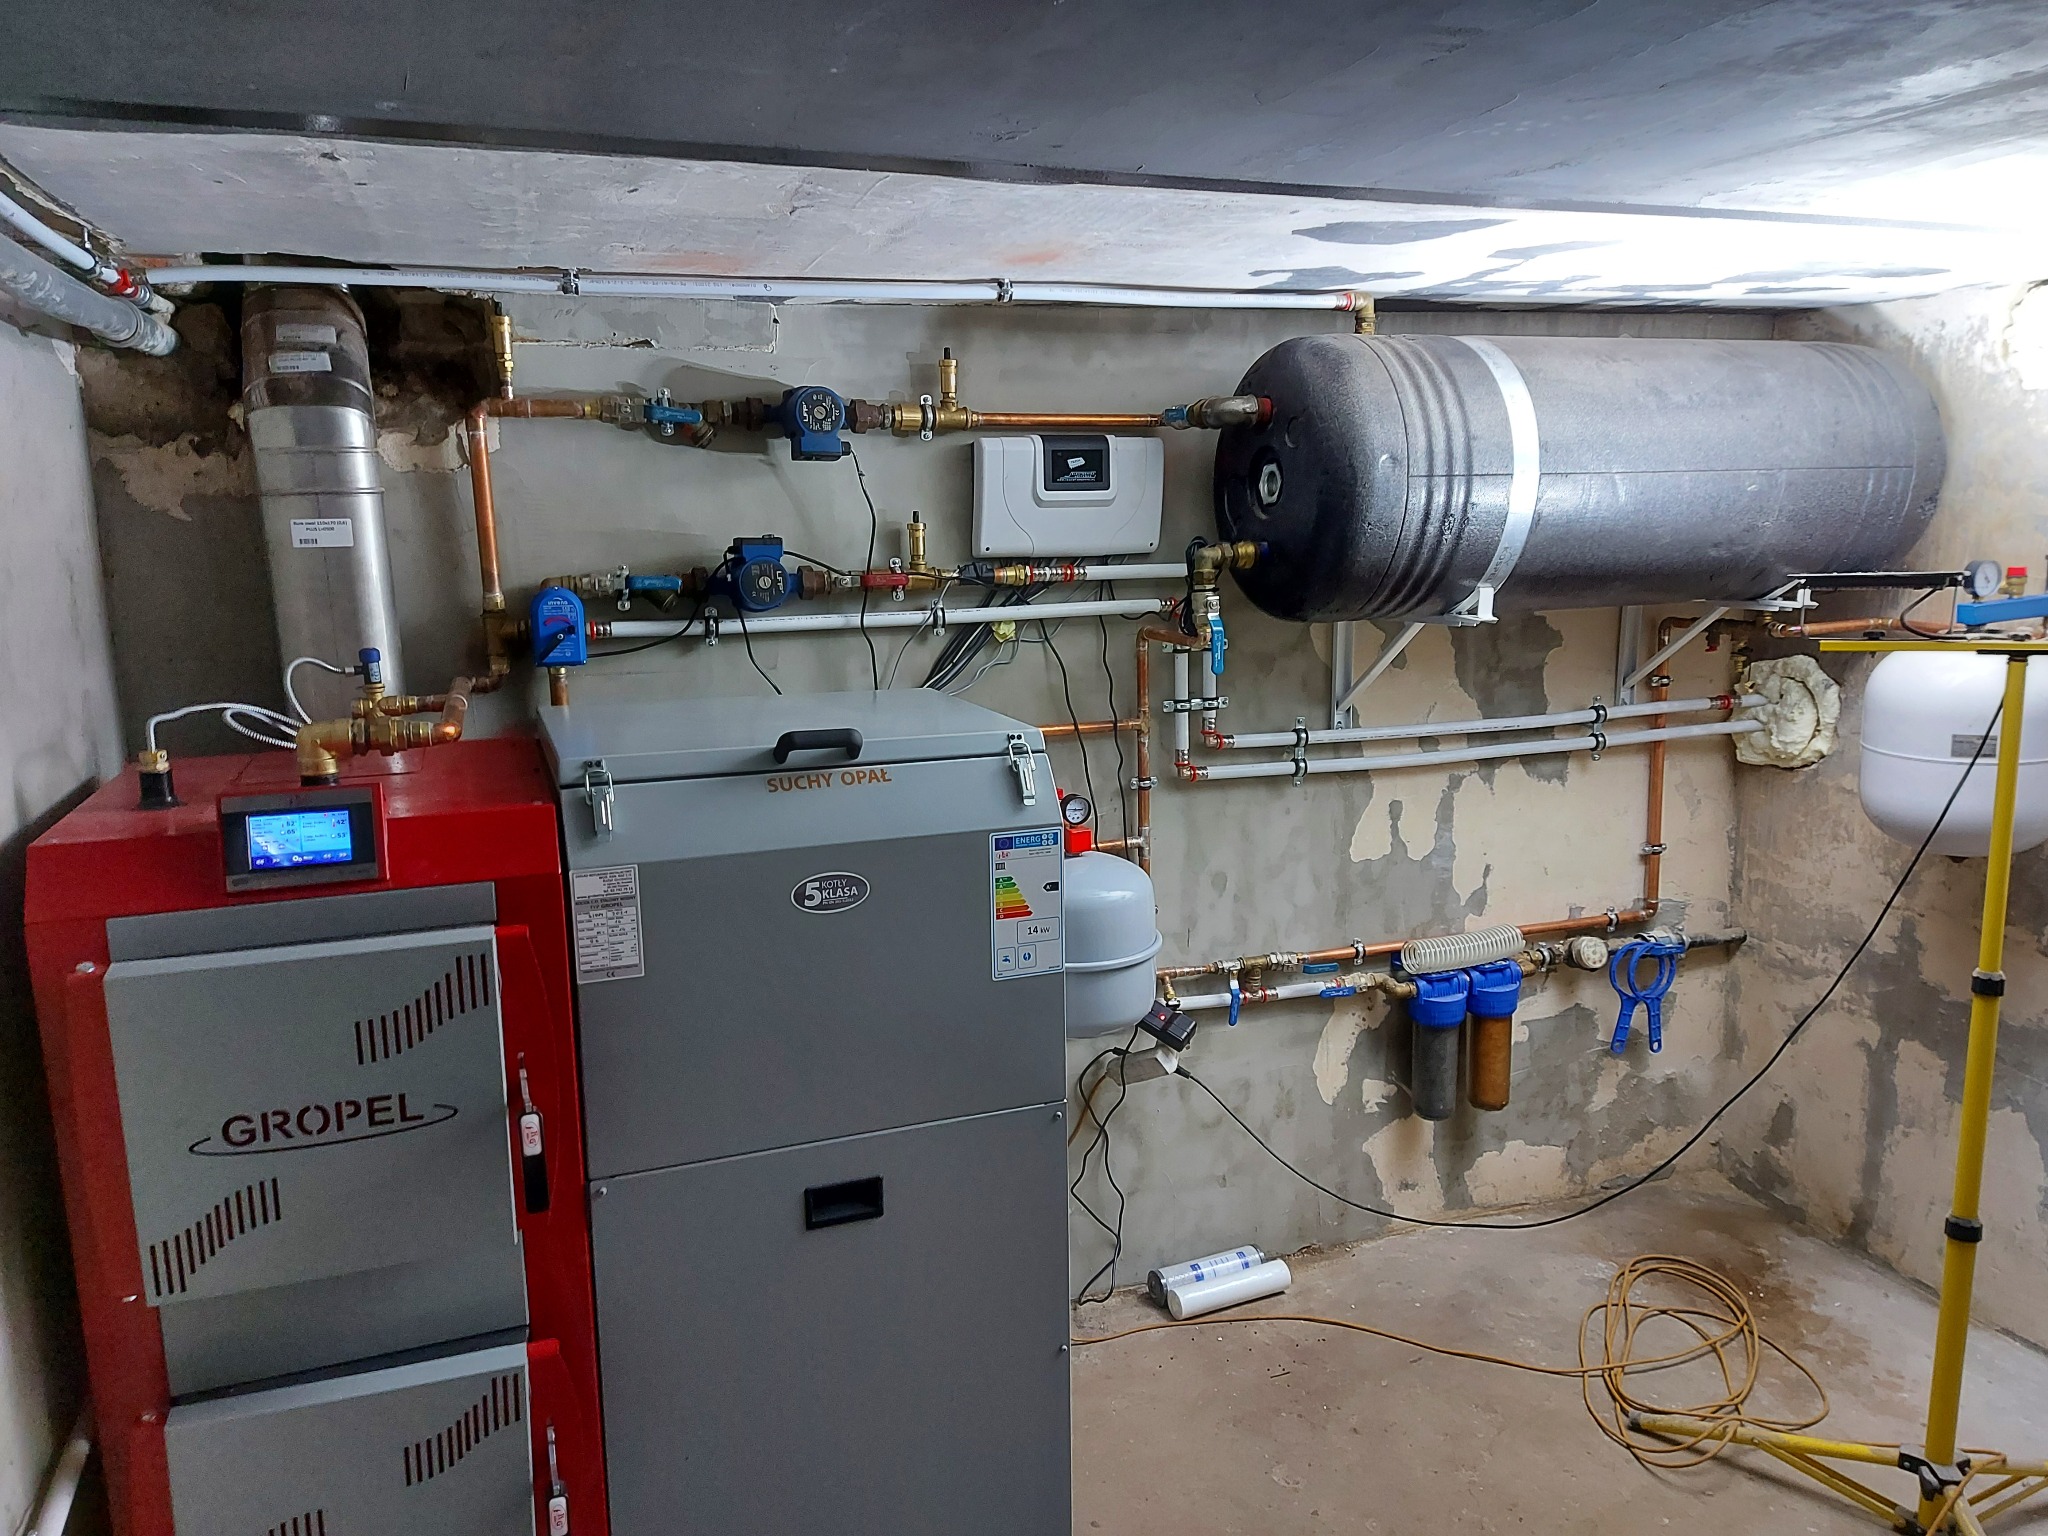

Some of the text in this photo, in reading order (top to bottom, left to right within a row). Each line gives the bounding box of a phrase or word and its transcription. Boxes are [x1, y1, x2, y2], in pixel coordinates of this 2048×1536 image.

[766, 768, 893, 793] SUCHY OPAŁ
[1015, 835, 1041, 845] ENERG
[821, 879, 848, 889] KOTŁY
[804, 881, 822, 907] 5
[822, 886, 858, 899] KLASA
[1027, 925, 1051, 935] 14 kW
[221, 1092, 425, 1147] GROPEL
